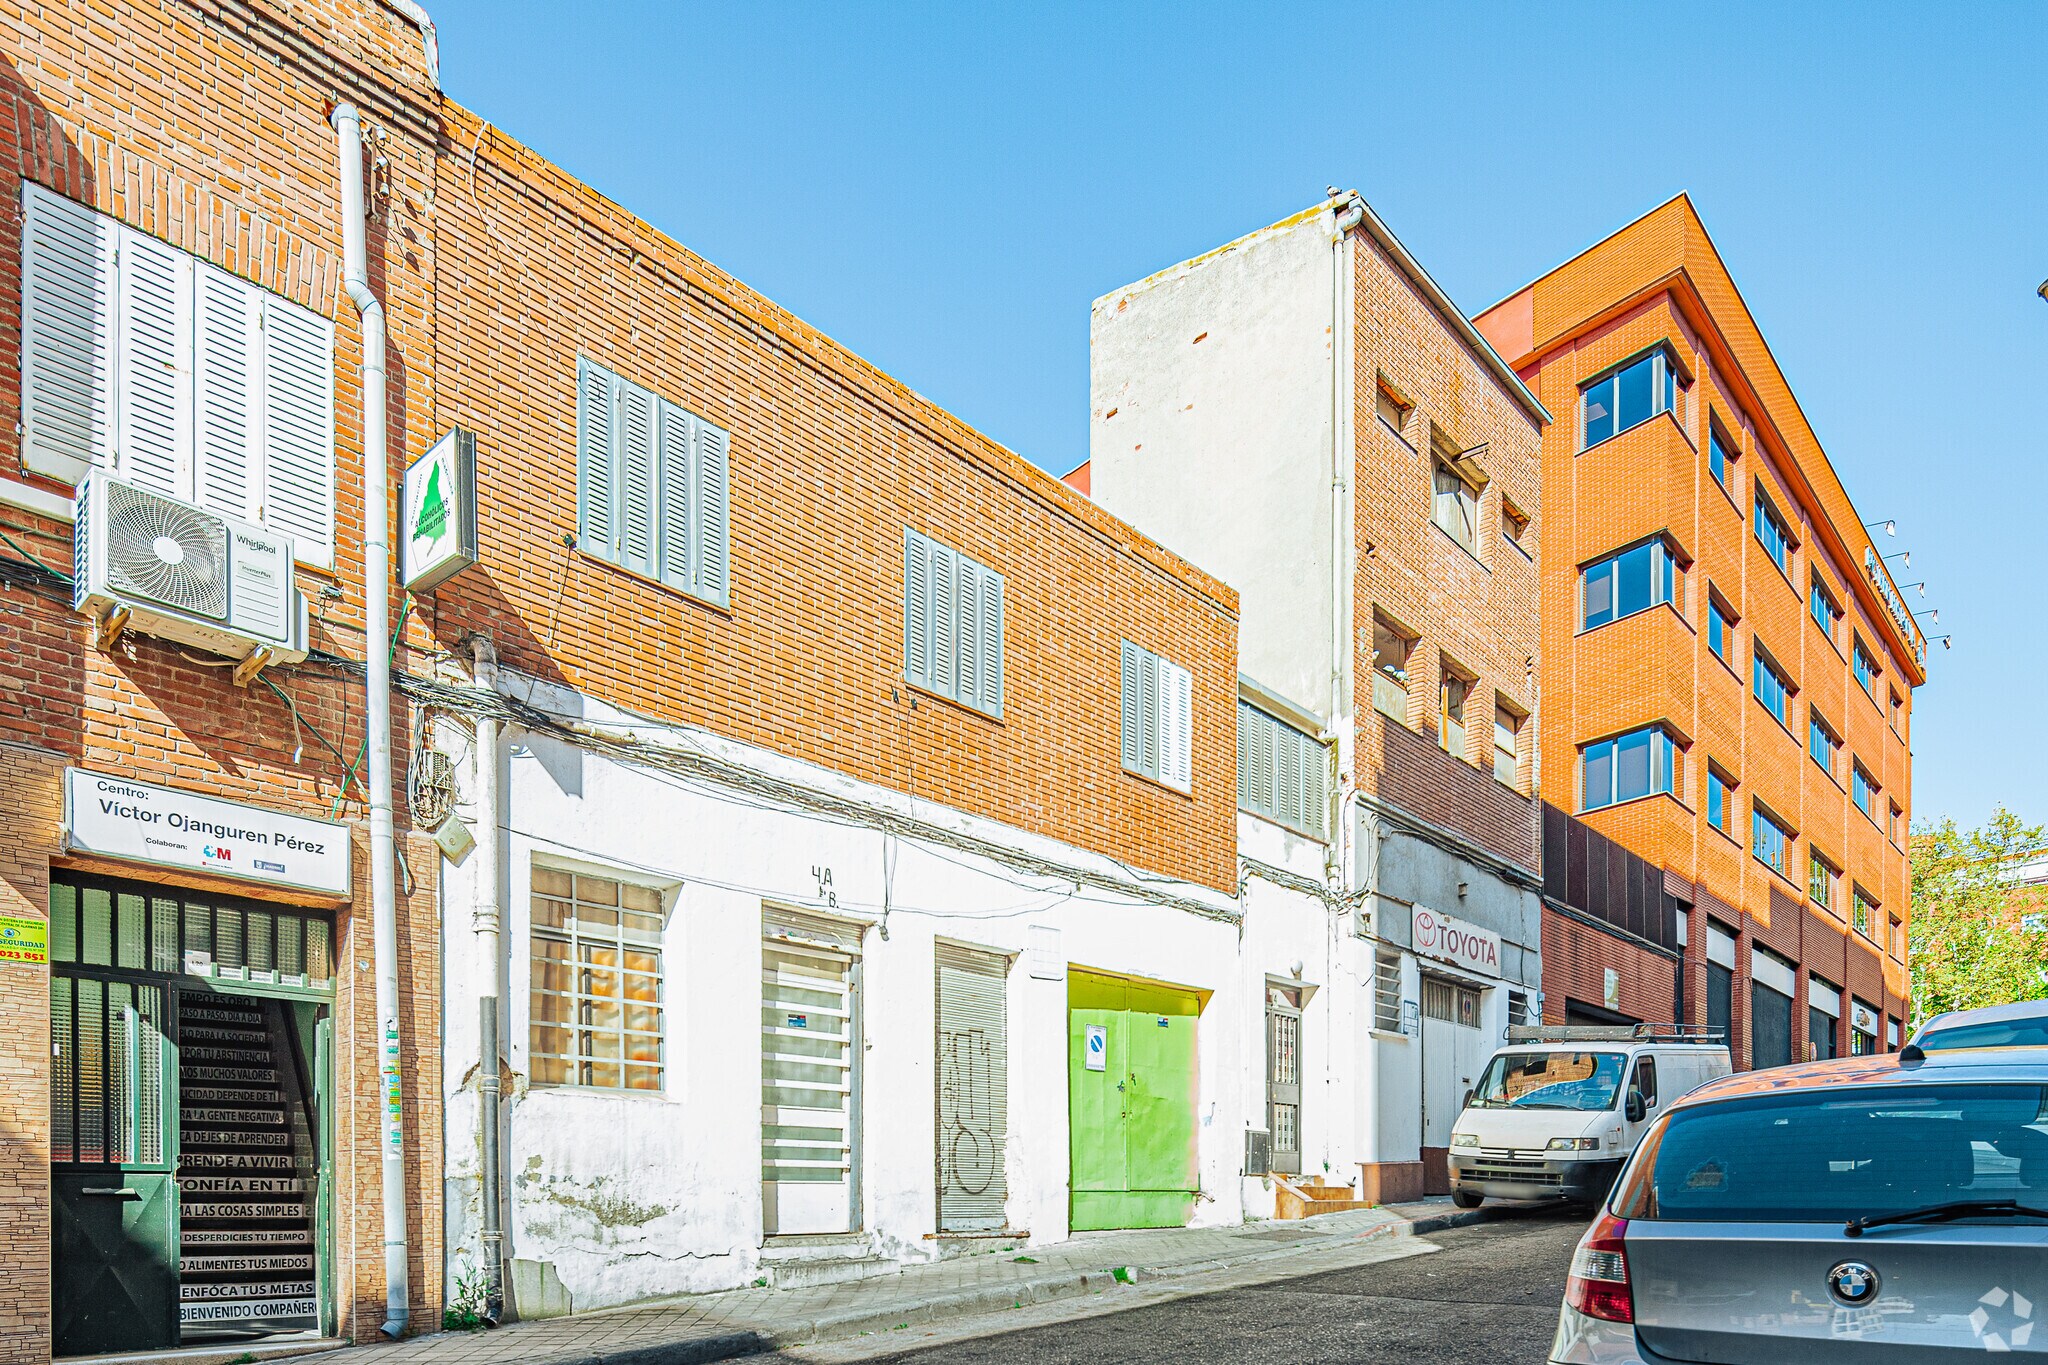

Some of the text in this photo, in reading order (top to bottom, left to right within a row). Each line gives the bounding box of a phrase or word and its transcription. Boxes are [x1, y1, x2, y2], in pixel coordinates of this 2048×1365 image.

[237, 534, 276, 554] Whirlpool
[97, 781, 149, 800] Centro:
[99, 798, 325, 855] Víctor Ojanguren Pérez
[145, 837, 188, 850] Colaboran:
[217, 847, 231, 860] M
[1438, 924, 1497, 966] TOYOTA
[24, 952, 45, 961] 851
[200, 1011, 205, 1019] A
[196, 1030, 215, 1039] PARA
[228, 1032, 265, 1043] SOCIEDAD
[185, 1047, 202, 1058] POR
[204, 1048, 214, 1059] TU
[216, 1049, 269, 1063] ABSTINENCIA
[200, 1067, 236, 1079] MUCHOS
[237, 1069, 273, 1080] VALORES
[217, 1091, 254, 1101] DEPENDE
[257, 1091, 267, 1101] DE
[194, 1110, 205, 1120] LA
[208, 1111, 236, 1121] GENTE
[238, 1111, 281, 1122] NEGATIVA
[194, 1131, 224, 1143] DEJES
[225, 1132, 236, 1143] DE
[238, 1133, 286, 1144] APRENDER
[237, 1156, 248, 1167] A
[250, 1156, 288, 1168] VIVIR
[249, 1180, 272, 1191] EN
[276, 1178, 292, 1191] TÍ
[195, 1205, 215, 1216] LAS
[218, 1205, 253, 1217] COSAS
[256, 1205, 299, 1217] SIMPLES
[184, 1233, 253, 1242] DESPERDICIES
[255, 1233, 268, 1241] TU
[269, 1233, 305, 1241] TIEMPO
[188, 1260, 246, 1270] ALIMENTES
[248, 1259, 267, 1269] TUS
[269, 1258, 308, 1269] MIEDOS
[1836, 1267, 1871, 1280] BMW
[182, 1283, 313, 1297] ENFÓCA TUS METAS
[180, 1300, 316, 1320] BIENVENIDO COMPAÑER
